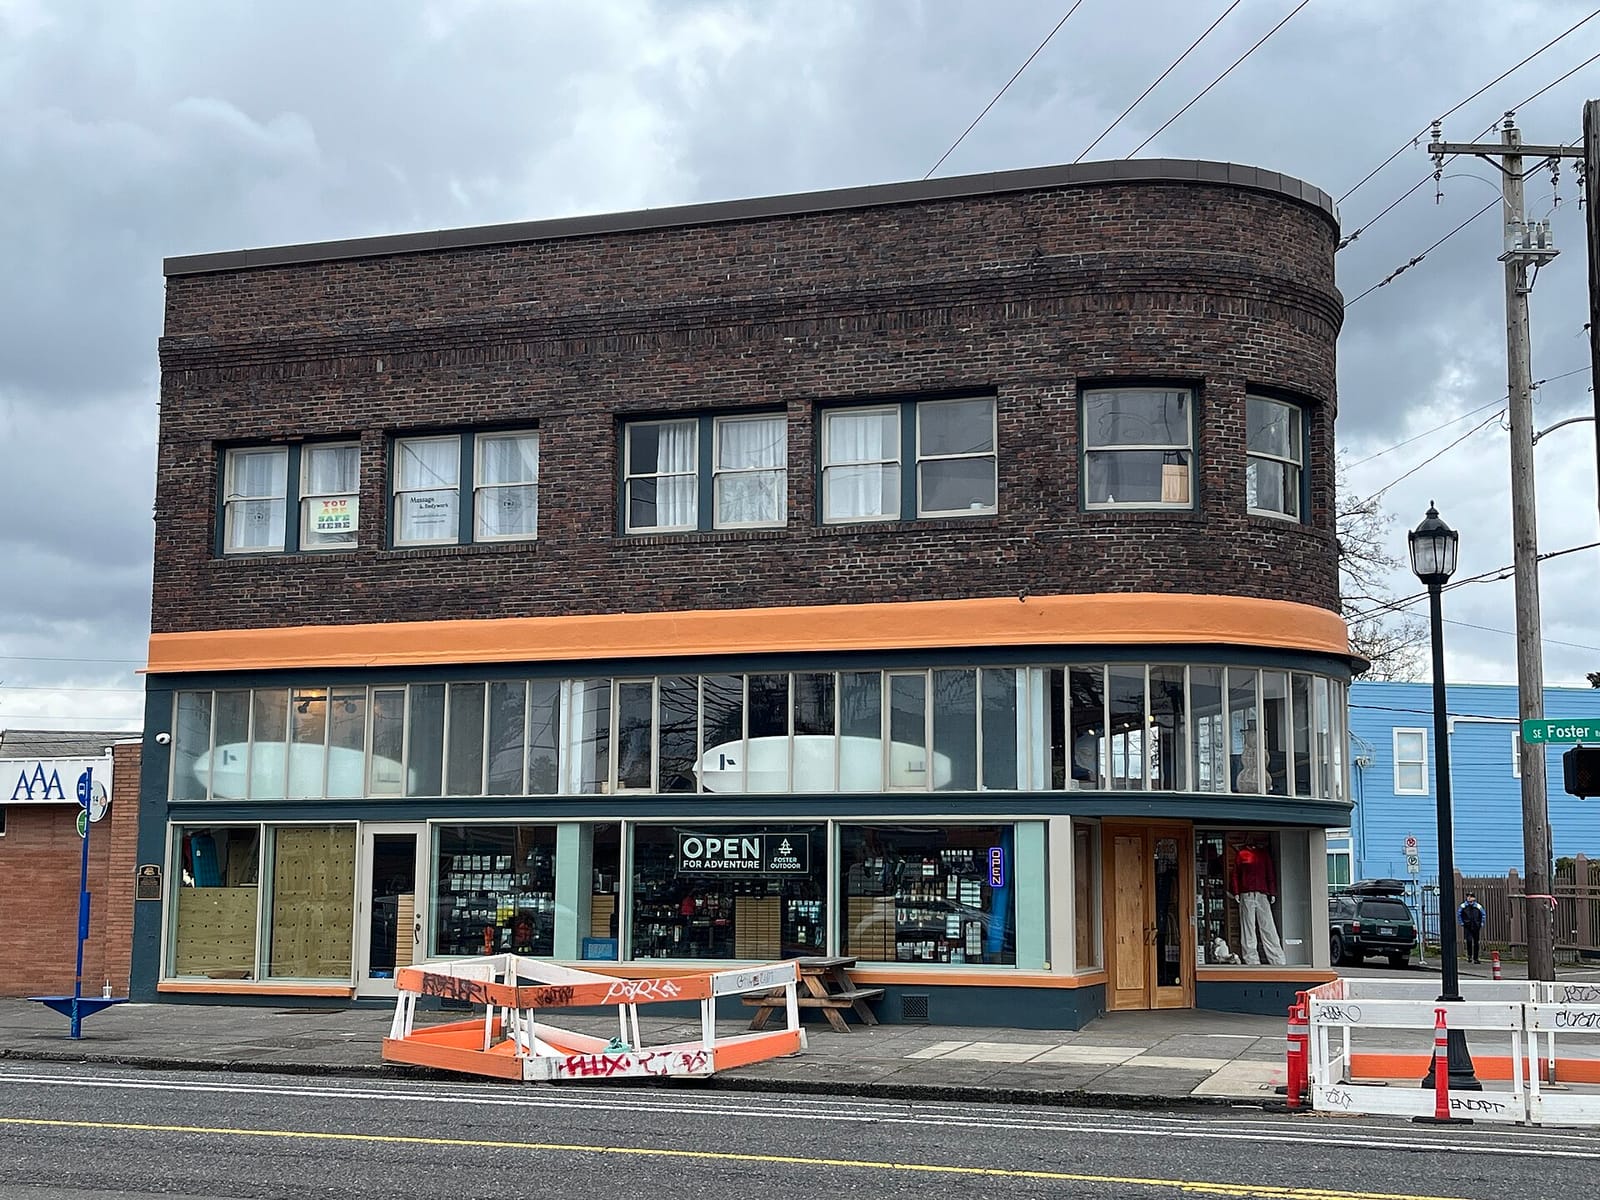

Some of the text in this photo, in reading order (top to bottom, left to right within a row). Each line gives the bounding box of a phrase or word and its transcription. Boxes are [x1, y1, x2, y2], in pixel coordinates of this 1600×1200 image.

[1533, 729, 1542, 738] SE
[1547, 725, 1590, 738] Foster
[10, 761, 66, 800] AAA
[683, 838, 760, 858] OPEN
[683, 860, 760, 868] FOR ADVENTURE
[991, 850, 1001, 885] OPEN
